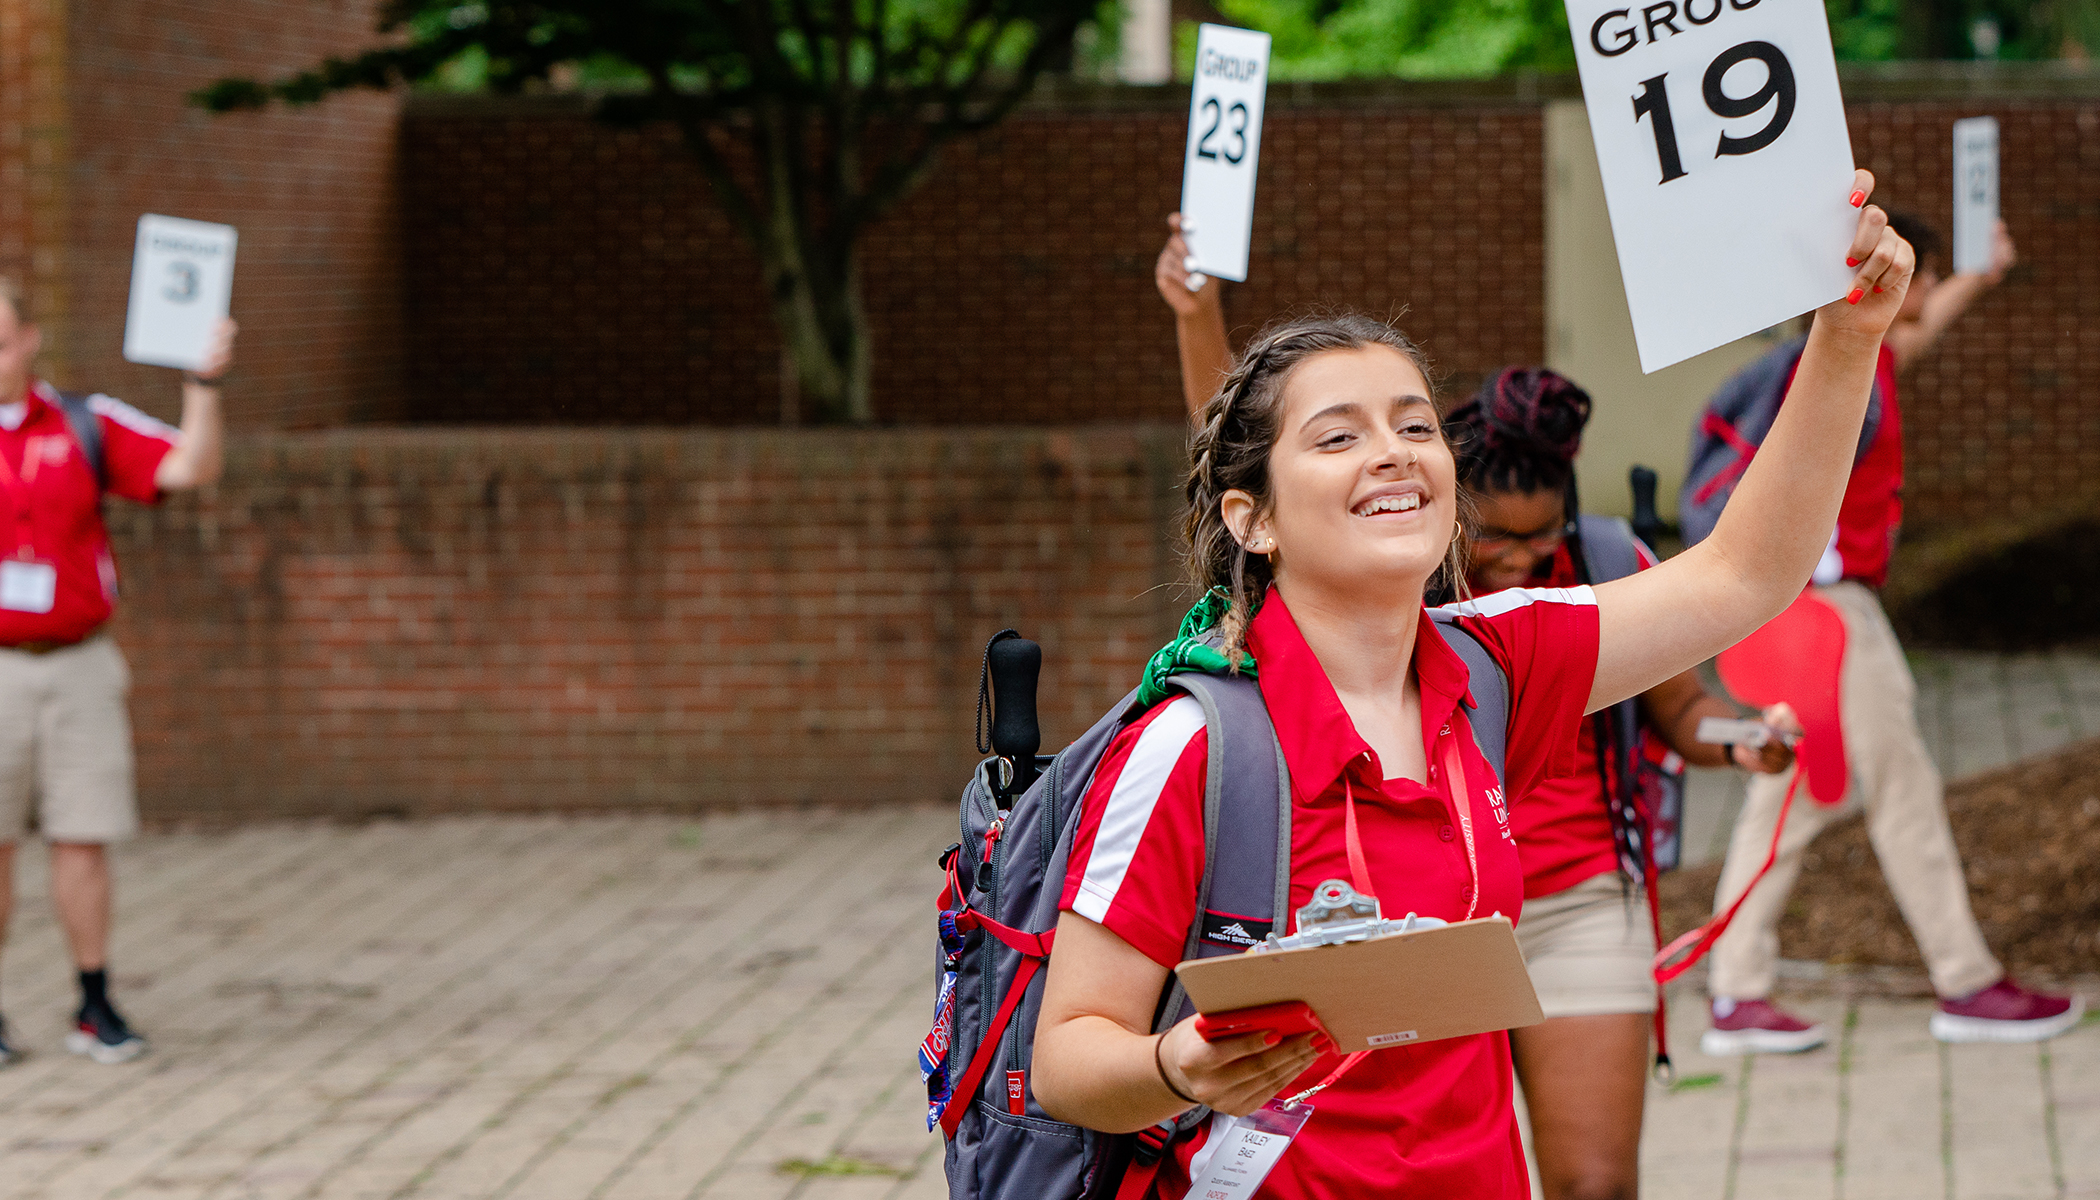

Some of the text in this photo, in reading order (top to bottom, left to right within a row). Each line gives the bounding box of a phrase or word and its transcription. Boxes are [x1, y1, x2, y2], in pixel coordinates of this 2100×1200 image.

[1590, 0, 1763, 57] GRO
[1198, 98, 1249, 164] 23
[1631, 41, 1797, 186] 19
[161, 260, 202, 306] 3
[1460, 814, 1479, 882] UNIVERSITY
[1208, 931, 1230, 942] HIGH
[1238, 1147, 1256, 1158] BAEZ
[1241, 1131, 1271, 1146] KAILEY
